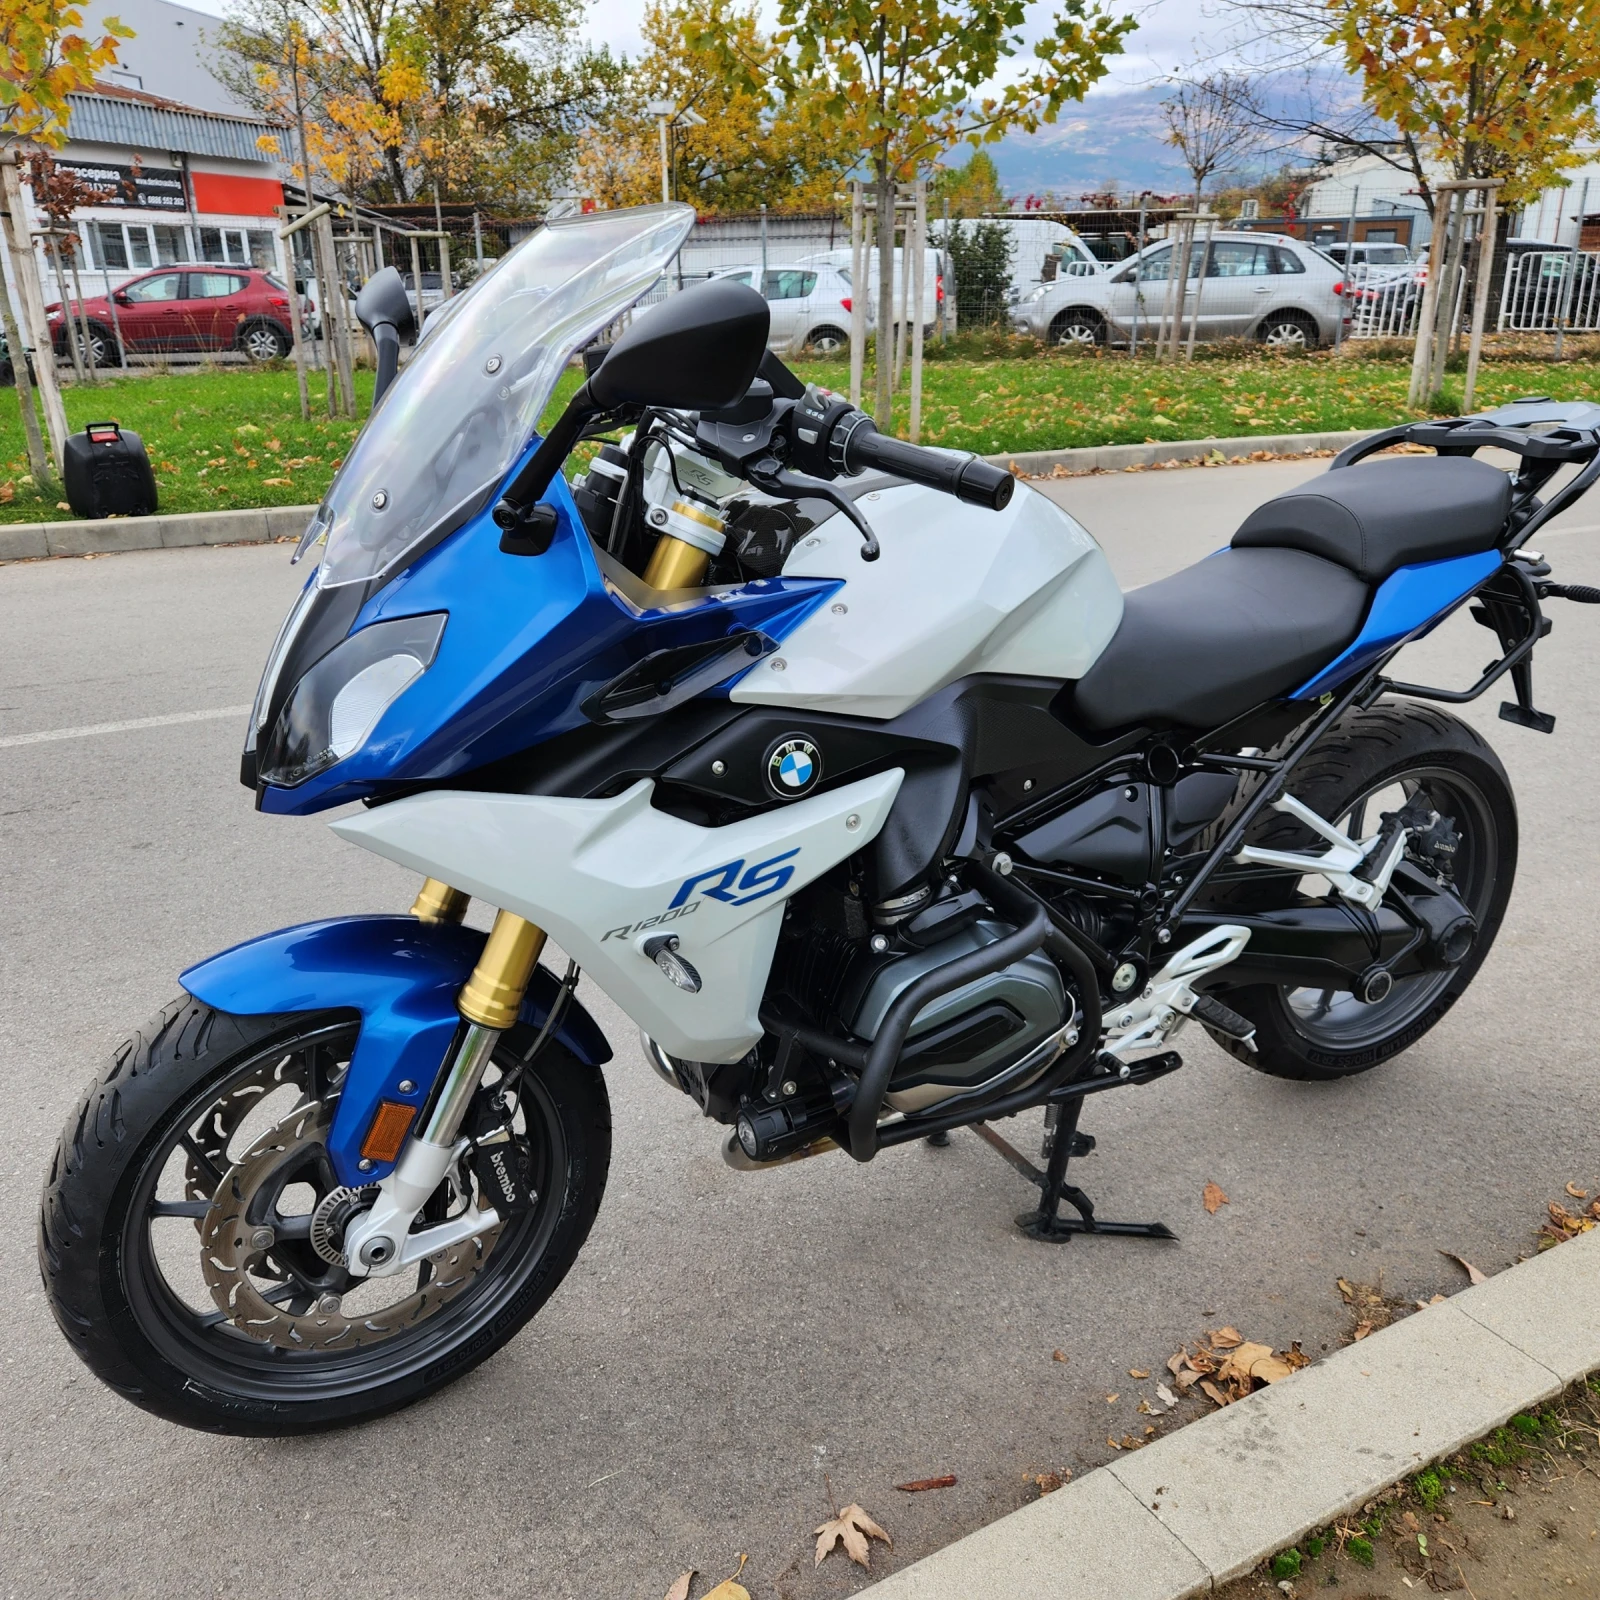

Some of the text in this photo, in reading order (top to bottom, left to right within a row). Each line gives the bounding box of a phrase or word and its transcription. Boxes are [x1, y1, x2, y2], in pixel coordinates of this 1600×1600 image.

[690, 469, 714, 486] RS
[771, 742, 814, 768] BMW
[600, 847, 802, 943] R1200 RS
[1380, 1010, 1438, 1057] MICHELIN
[490, 1150, 516, 1203] brembo
[498, 1272, 542, 1328] MICHELIN
